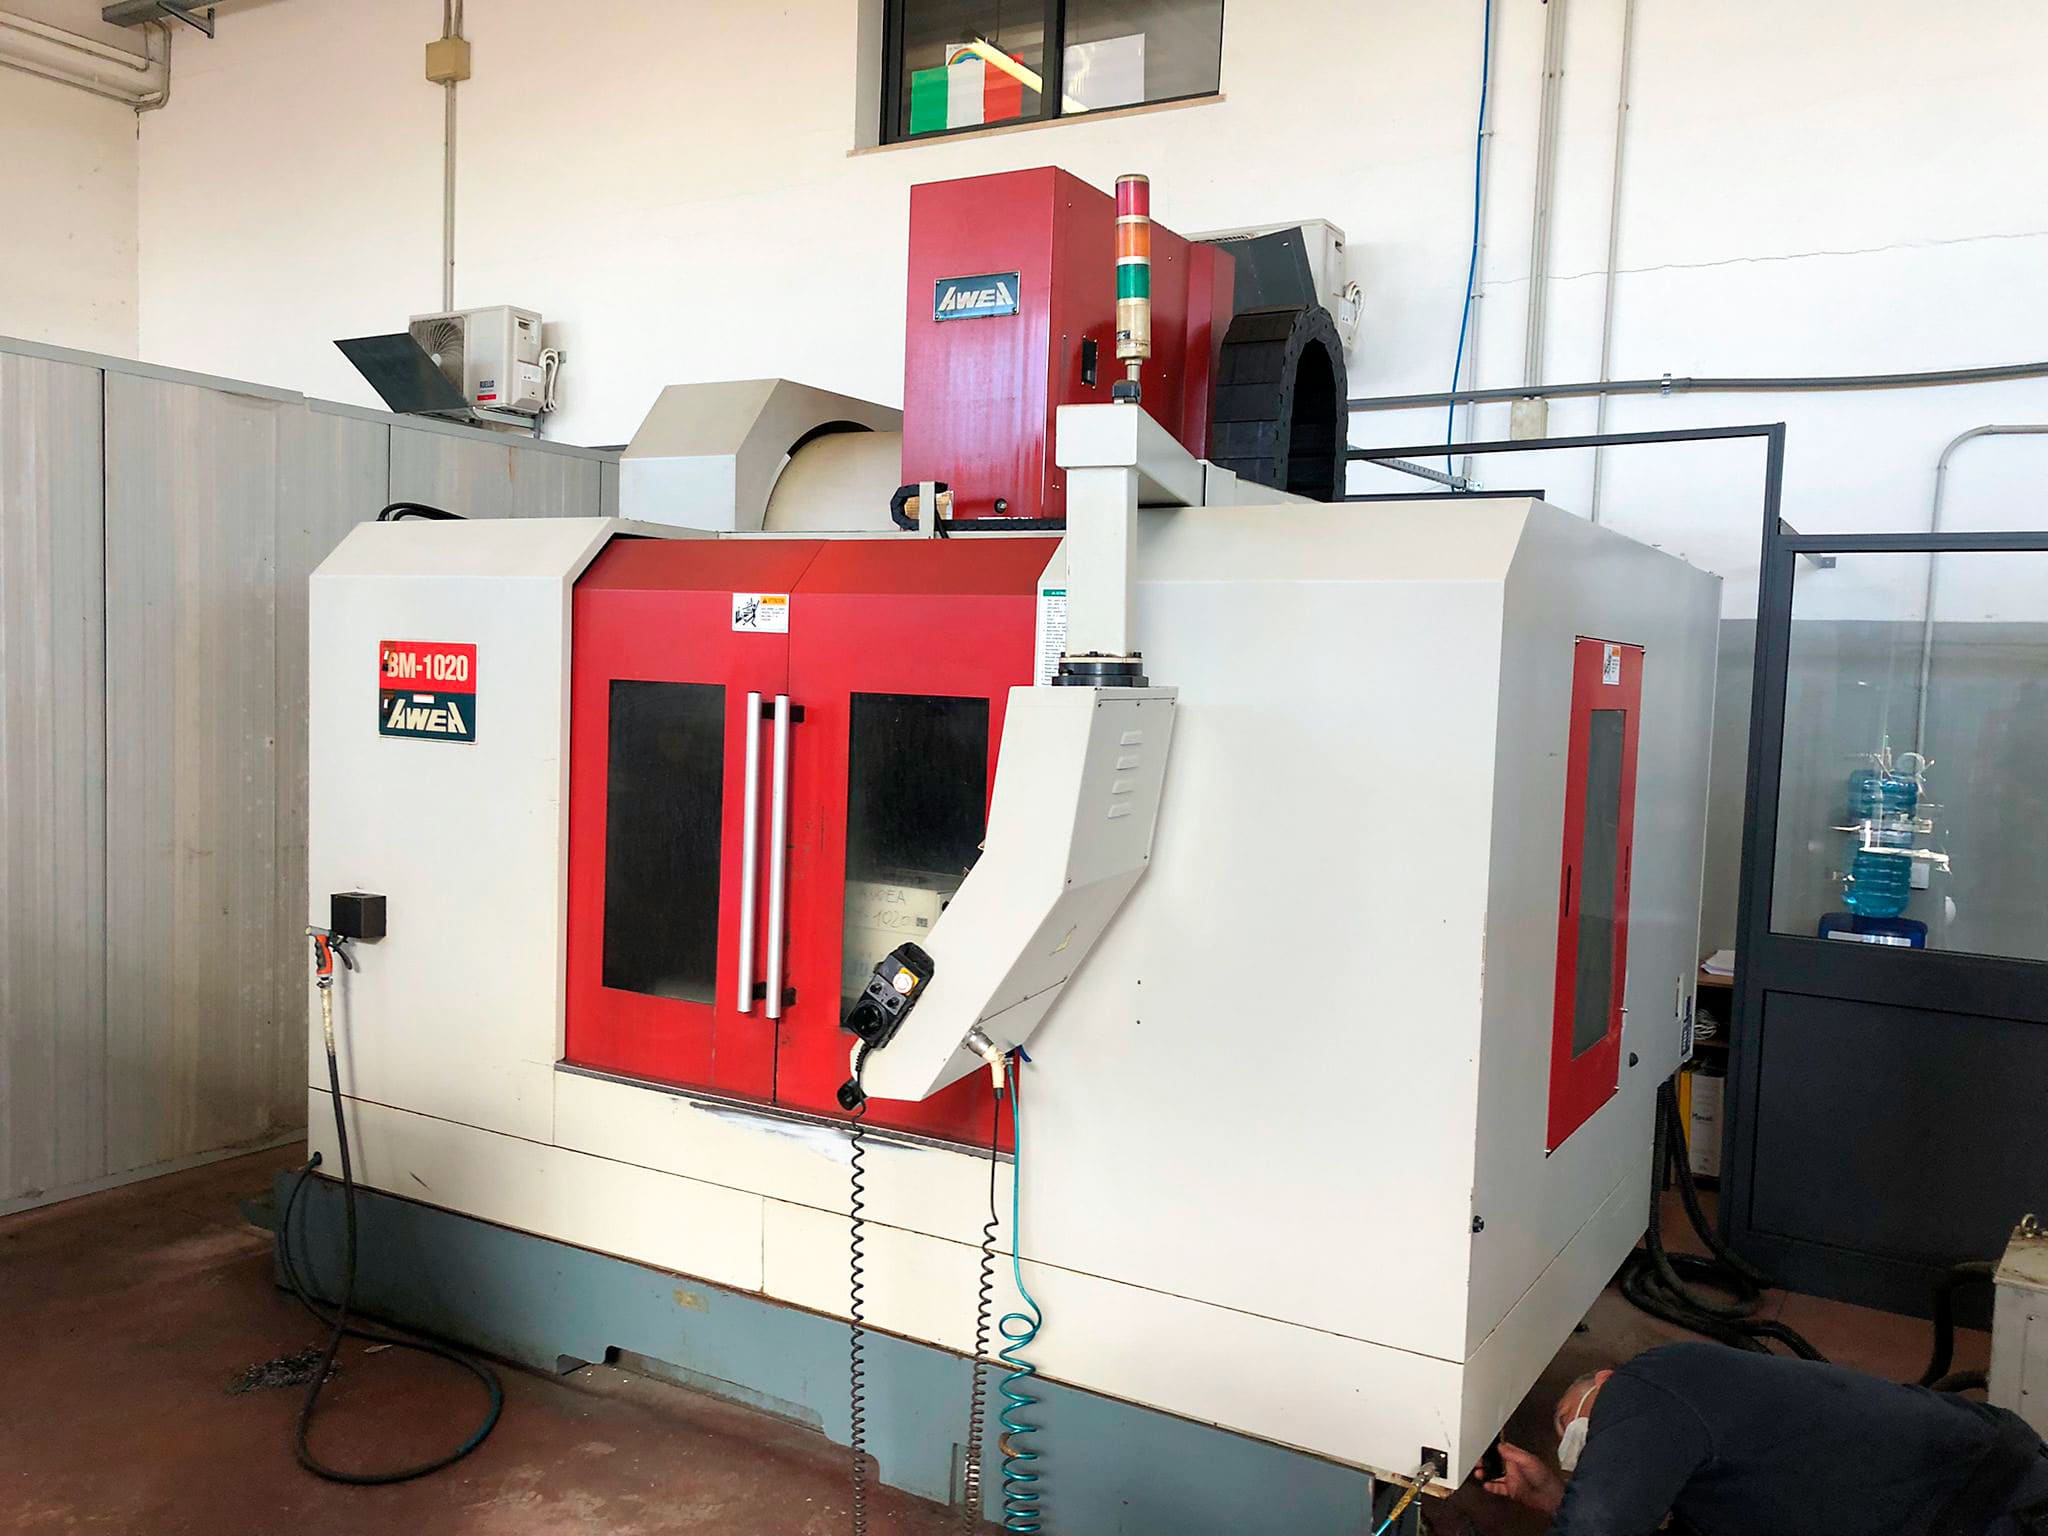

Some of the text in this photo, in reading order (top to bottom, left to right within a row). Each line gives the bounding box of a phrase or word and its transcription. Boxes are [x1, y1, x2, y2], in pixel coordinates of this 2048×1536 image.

[938, 282, 1015, 311] AWEA
[386, 652, 468, 681] BM-1020
[387, 699, 467, 733] AWEA
